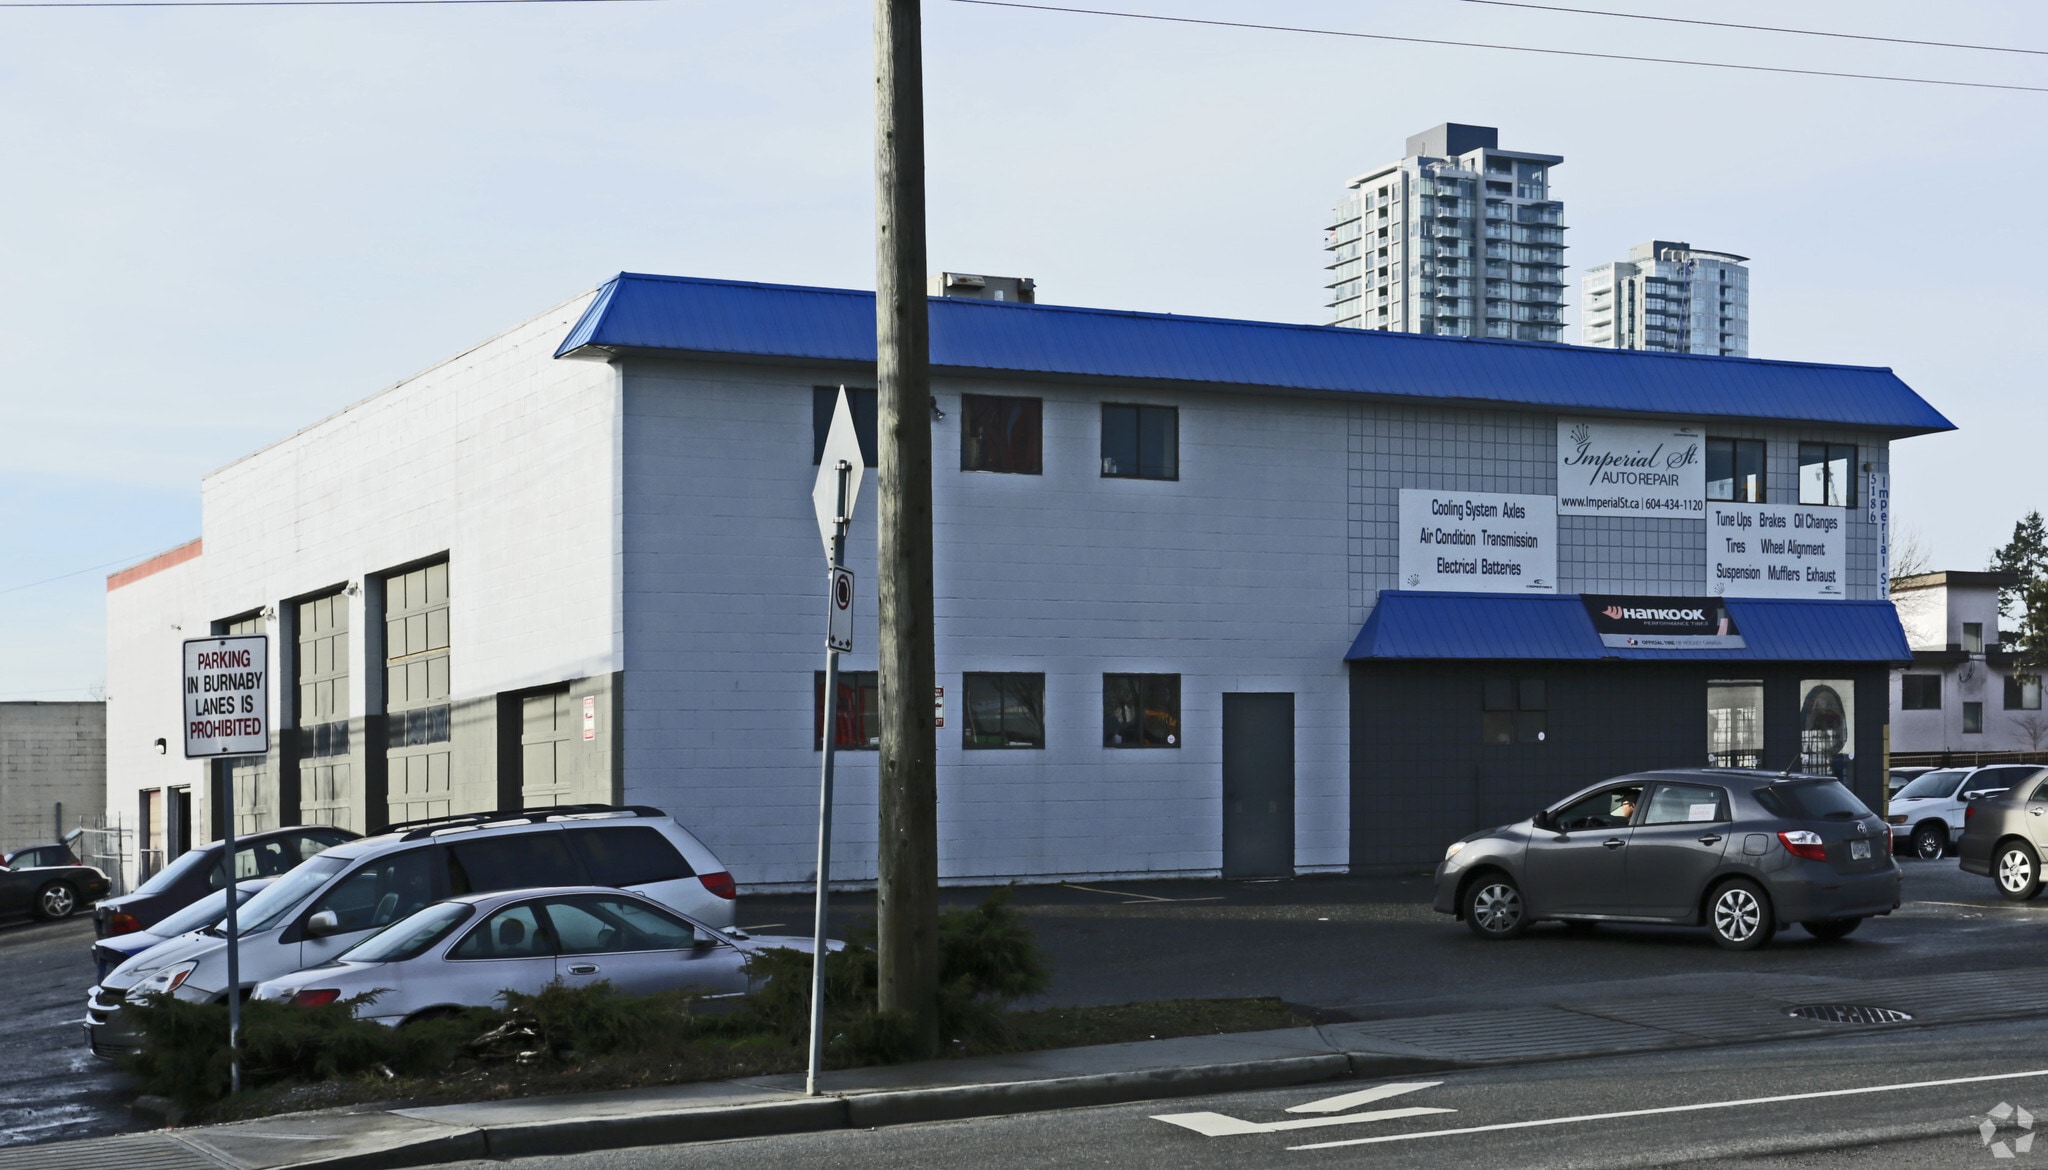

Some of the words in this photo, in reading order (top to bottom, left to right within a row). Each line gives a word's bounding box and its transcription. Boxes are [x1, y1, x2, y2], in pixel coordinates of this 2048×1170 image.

[1564, 442, 1664, 486] Imperial
[1666, 443, 1698, 471] St.
[1432, 498, 1463, 521] Cooling
[1465, 500, 1497, 521] System
[1502, 502, 1526, 519] Axles
[1562, 496, 1639, 509] www.ImperialSt.ca
[1645, 499, 1703, 511] 604-434-1120
[1715, 511, 1735, 526] Tune
[1737, 512, 1752, 531] Ups
[1759, 512, 1786, 528] Brakes
[1794, 513, 1804, 529] Oil
[1806, 515, 1838, 533] Changes
[1878, 476, 1889, 568] Imperial
[1420, 527, 1434, 544] Air
[1435, 528, 1476, 546] Condition
[1481, 529, 1538, 548] Transmission
[1726, 538, 1746, 553] Tires
[1761, 538, 1785, 554] Wheel
[1787, 539, 1826, 559] Alignment
[1437, 557, 1477, 574] Electrical
[1481, 558, 1522, 576] Batteries
[1716, 563, 1761, 583] Suspension
[1767, 565, 1800, 582] Mufflers
[1806, 566, 1836, 583] Exhaust
[198, 649, 250, 670] PARKING
[187, 676, 198, 694] IN
[204, 671, 262, 692] BURNABY
[195, 695, 235, 716] LANES
[241, 694, 254, 713] IS
[190, 717, 261, 739] PROHIBITED
